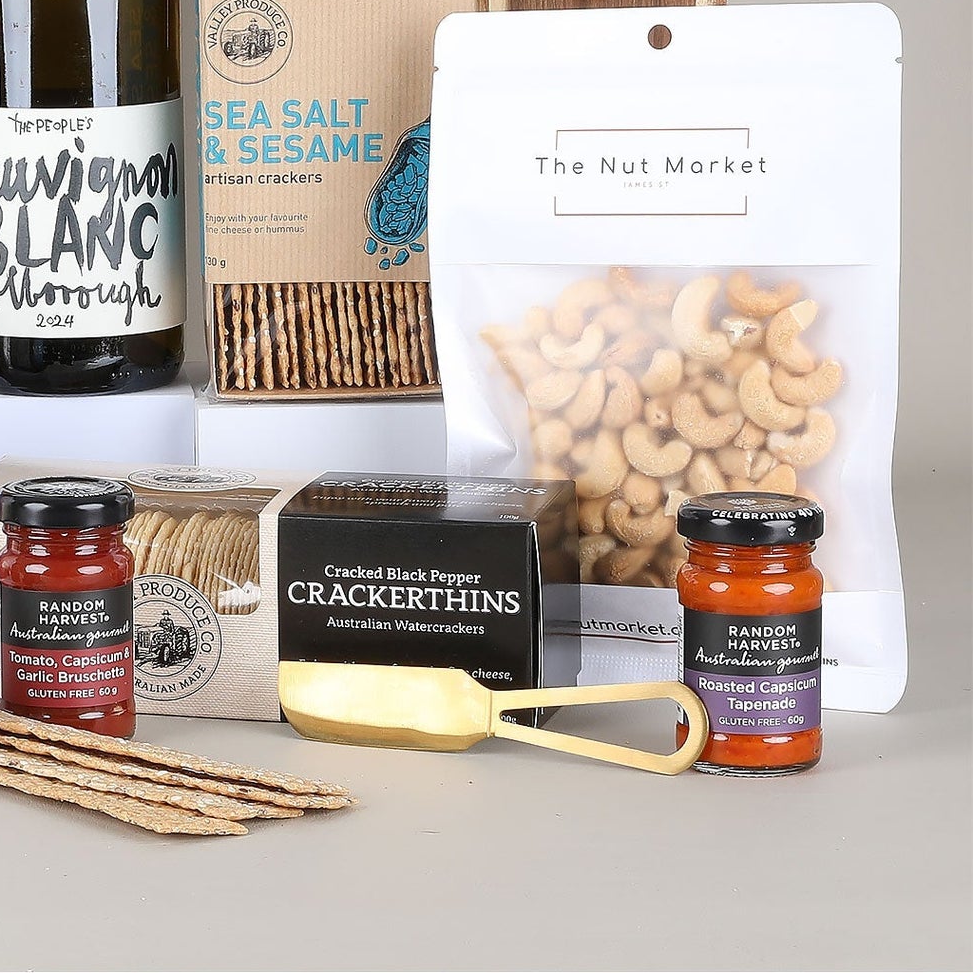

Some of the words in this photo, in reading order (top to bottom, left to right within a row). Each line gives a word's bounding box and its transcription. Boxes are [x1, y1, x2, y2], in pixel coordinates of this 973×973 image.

[208, 3, 233, 49] VALLEY
[234, 0, 285, 29] PRODUCE
[277, 31, 287, 48] CO.
[205, 101, 271, 129] SEA
[282, 99, 368, 128] SALT
[205, 136, 227, 164] &
[238, 134, 383, 164] SESAME
[536, 157, 584, 174] The
[601, 157, 648, 174] Nut
[666, 157, 766, 173] Market
[205, 172, 253, 184] artisan
[258, 171, 322, 184] crackers
[228, 214, 246, 222] with
[248, 215, 268, 224] your
[271, 213, 308, 222] favourite
[221, 225, 251, 234] cheese
[267, 225, 304, 233] hummus
[220, 259, 226, 268] g
[36, 314, 74, 327] 2024
[712, 510, 796, 520] CELEBRATING
[798, 509, 813, 518] 40
[324, 565, 383, 579] Cracked
[387, 568, 427, 582] Black
[429, 569, 481, 586] Pepper
[40, 599, 104, 612] RANDOM
[288, 581, 521, 614] CRACKERTHINS
[139, 582, 211, 627] PRODUCE
[199, 631, 214, 655] CO.
[327, 616, 392, 631] Australian
[394, 620, 485, 635] Watercrackers
[10, 621, 85, 640] Australian
[729, 625, 796, 637] RANDOM
[9, 651, 58, 668] Tomato,
[62, 651, 123, 668] Capsicum
[124, 647, 130, 659] &
[695, 647, 775, 666] Australian
[17, 669, 54, 683] Garlic
[58, 667, 125, 683] Bruschetta
[134, 677, 177, 693] RALIAN
[179, 664, 206, 689] MADE
[472, 668, 513, 681] cheese,
[28, 689, 67, 698] GLUTEN
[69, 689, 94, 698] FREE
[698, 677, 755, 693] Roasted
[760, 677, 817, 694] Capsicum
[727, 697, 796, 712] Tapenade
[719, 717, 755, 726] GLUTEN
[758, 718, 780, 726] FREE
[788, 715, 804, 724] 60g
